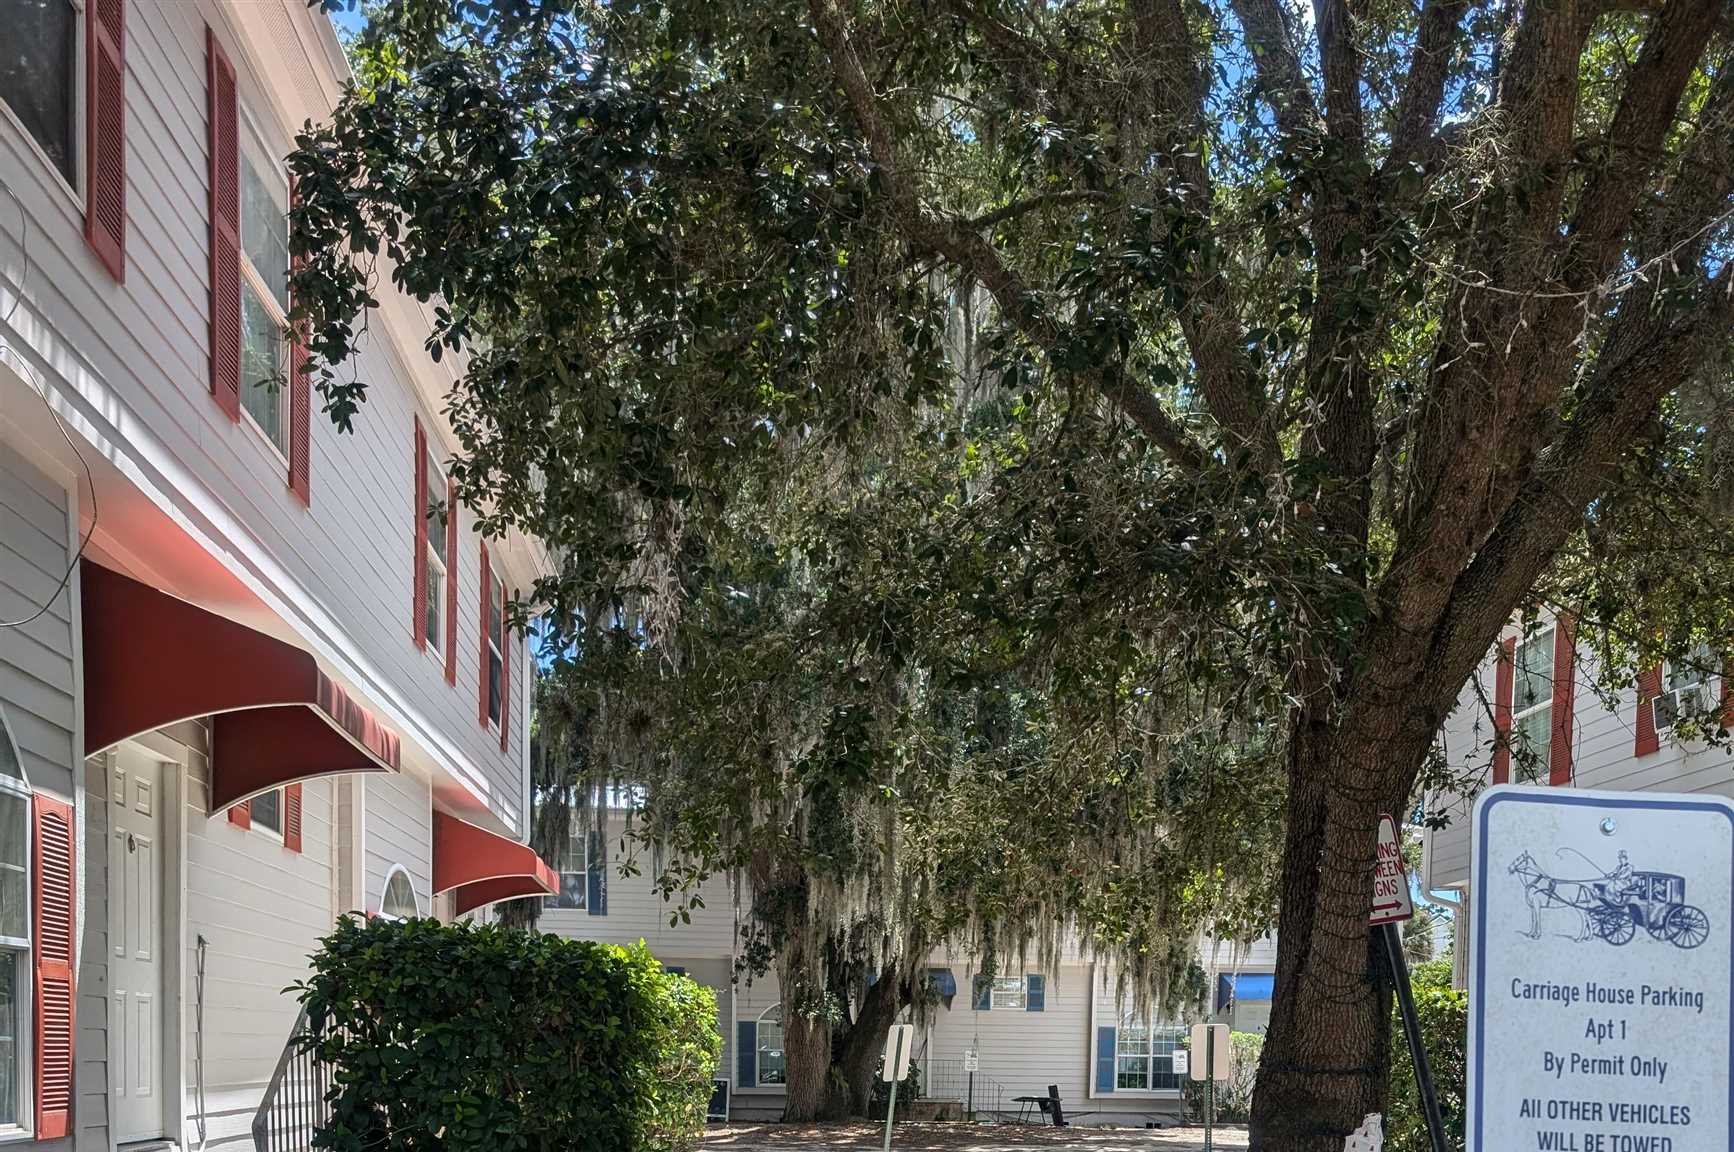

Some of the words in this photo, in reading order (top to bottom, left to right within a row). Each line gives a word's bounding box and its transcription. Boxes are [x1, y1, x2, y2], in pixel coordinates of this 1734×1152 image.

[1377, 841, 1398, 857] ING
[1375, 860, 1403, 878] WEEN
[1374, 879, 1398, 897] GNS
[1511, 977, 1580, 1007] Carriage
[1585, 982, 1634, 1004] House
[1640, 985, 1704, 1013] Parking
[1585, 1017, 1614, 1045] Apt
[1619, 1019, 1627, 1040] 1
[1543, 1051, 1565, 1079] By
[1570, 1052, 1625, 1076] Permit
[1630, 1055, 1668, 1084] Only
[1547, 1099, 1603, 1122] OTHER
[1609, 1102, 1691, 1126] VEHICLES
[1537, 1130, 1579, 1152] WILL
